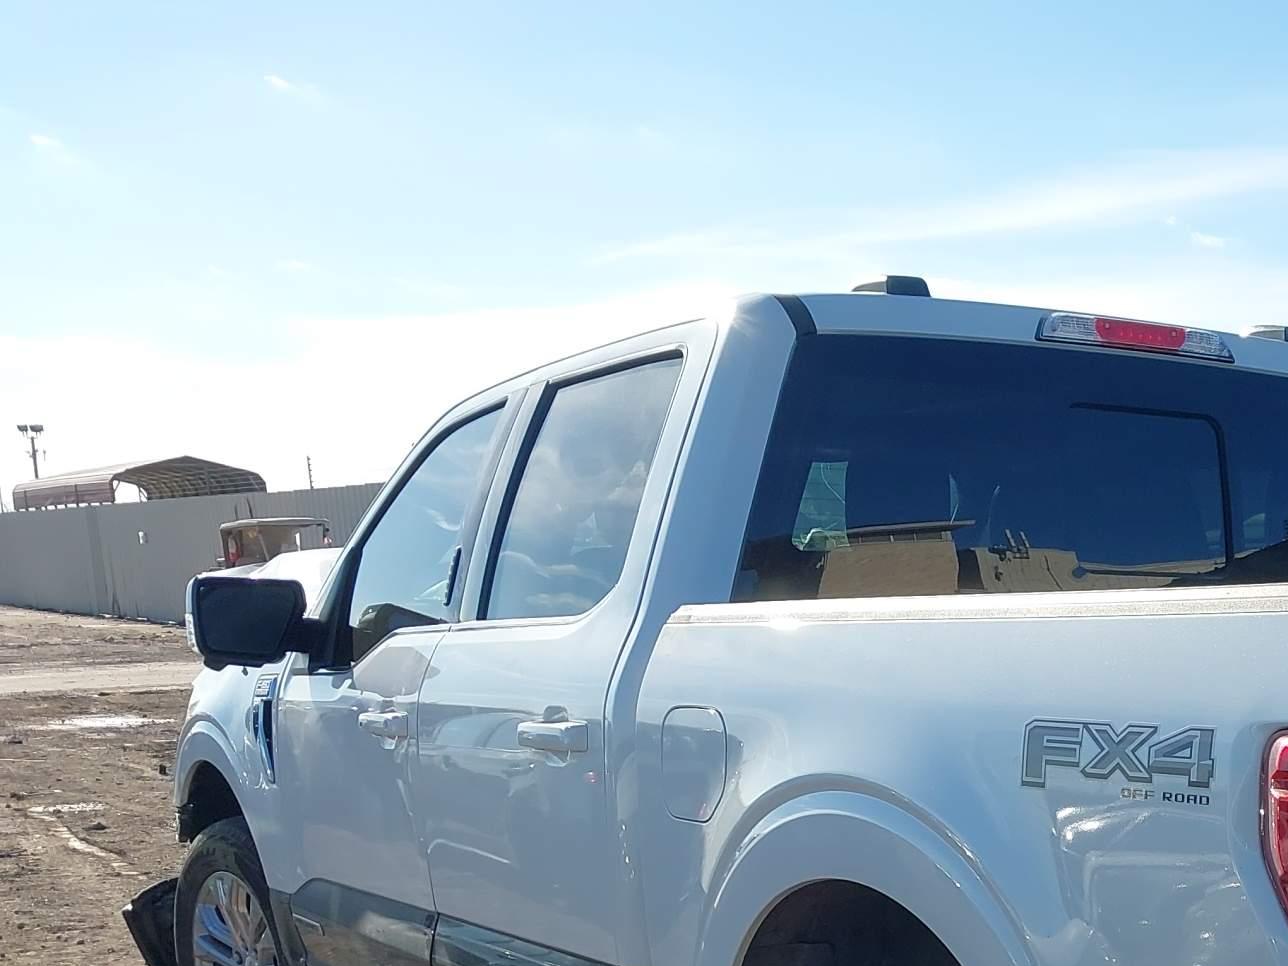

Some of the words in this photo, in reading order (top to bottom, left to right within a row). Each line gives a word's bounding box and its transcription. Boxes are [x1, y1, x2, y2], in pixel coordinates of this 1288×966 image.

[1020, 716, 1217, 788] FX4
[1120, 788, 1155, 801] OFF
[1162, 791, 1210, 806] ROAD
